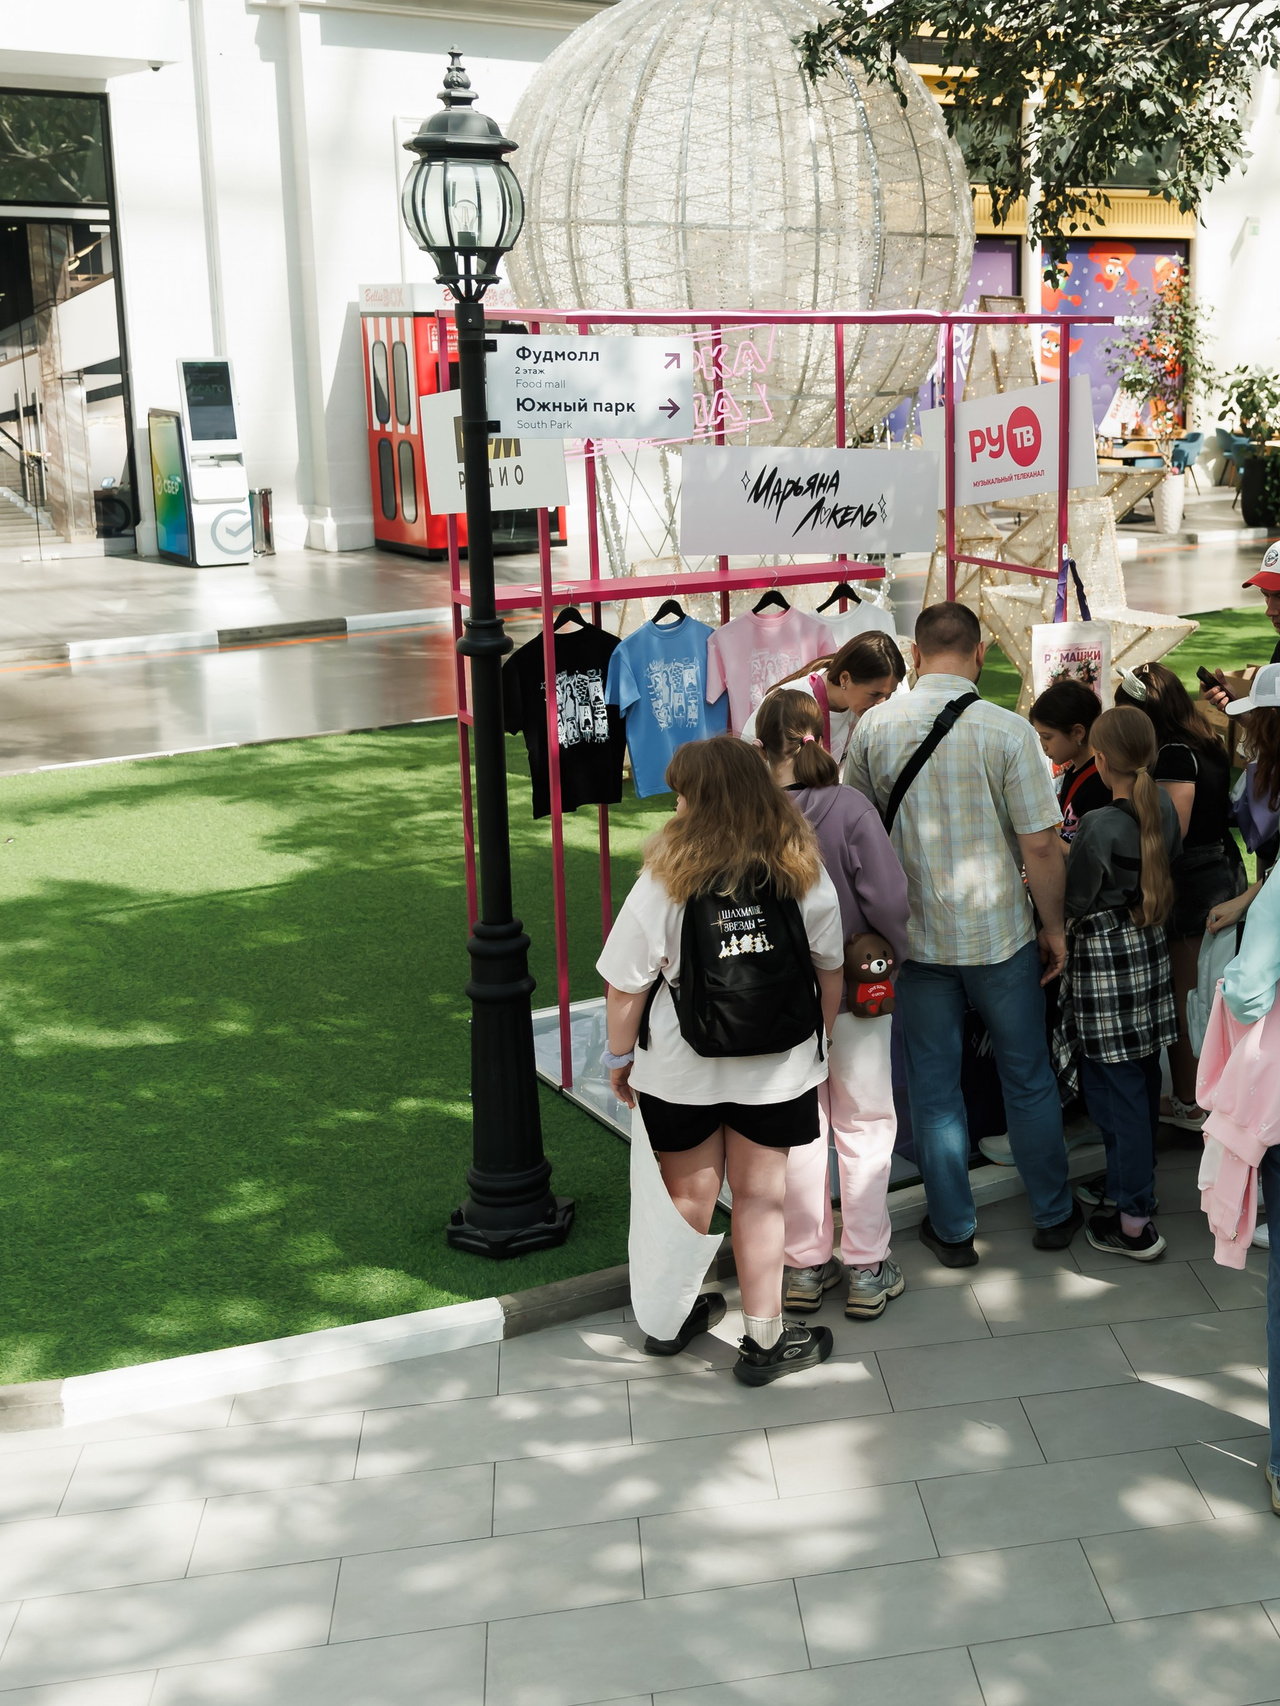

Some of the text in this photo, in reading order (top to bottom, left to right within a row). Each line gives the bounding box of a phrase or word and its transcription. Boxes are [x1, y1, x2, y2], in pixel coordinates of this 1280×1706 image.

[515, 345, 600, 363] Фудмолл
[514, 366, 521, 375] 2
[516, 379, 566, 389] Food mall
[516, 397, 636, 416] Южный парк
[517, 419, 573, 430] South Park
[972, 469, 1045, 488] МУЗЫКАЛЬНЫЙ ТЕЛЕКАНАЛ
[163, 479, 180, 495] СБЕР
[723, 919, 756, 933] ЗВЕЗДЫ
